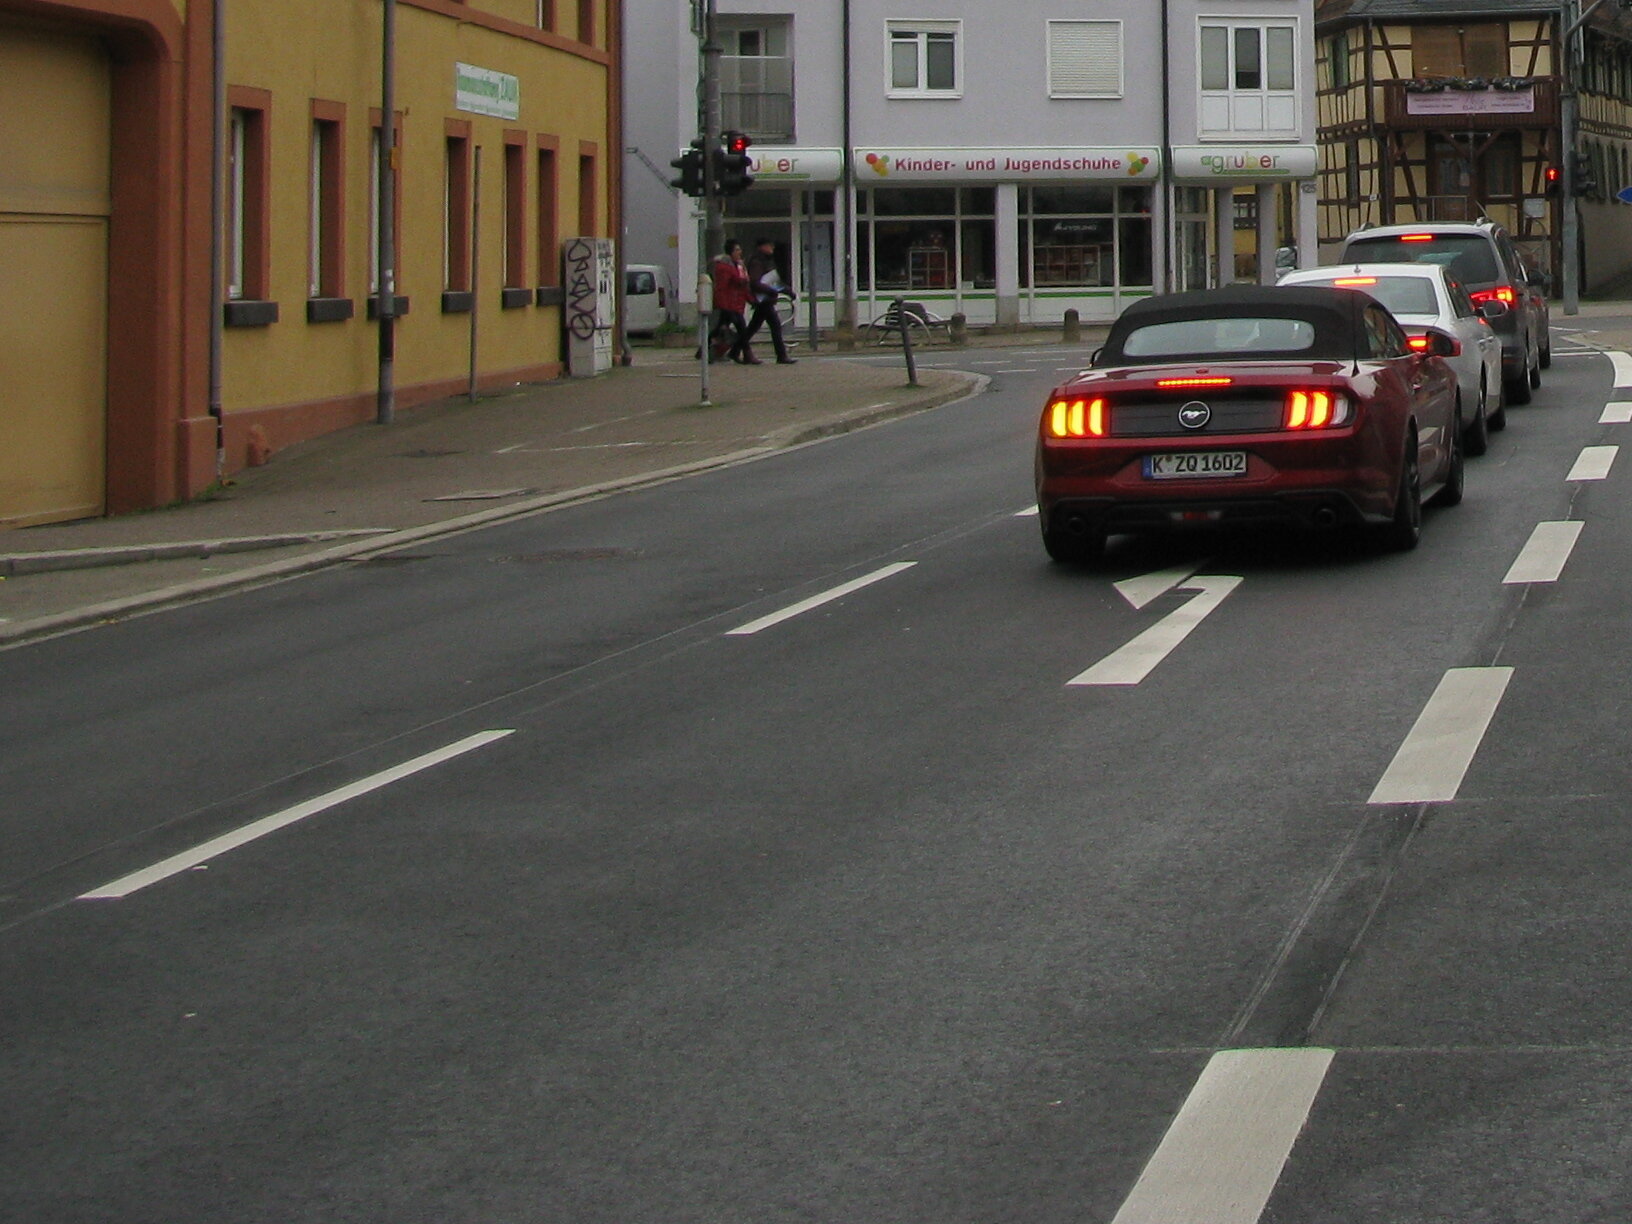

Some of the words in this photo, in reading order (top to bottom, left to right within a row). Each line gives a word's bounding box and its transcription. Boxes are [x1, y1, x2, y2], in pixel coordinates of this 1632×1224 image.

[895, 157, 956, 171] Kinder-
[965, 157, 996, 171] und
[1004, 157, 1122, 172] Jugendschuhe
[1211, 151, 1281, 175] gruber
[1153, 457, 1163, 473] K
[1175, 455, 1198, 472] ZQ
[1202, 454, 1244, 471] 1602
